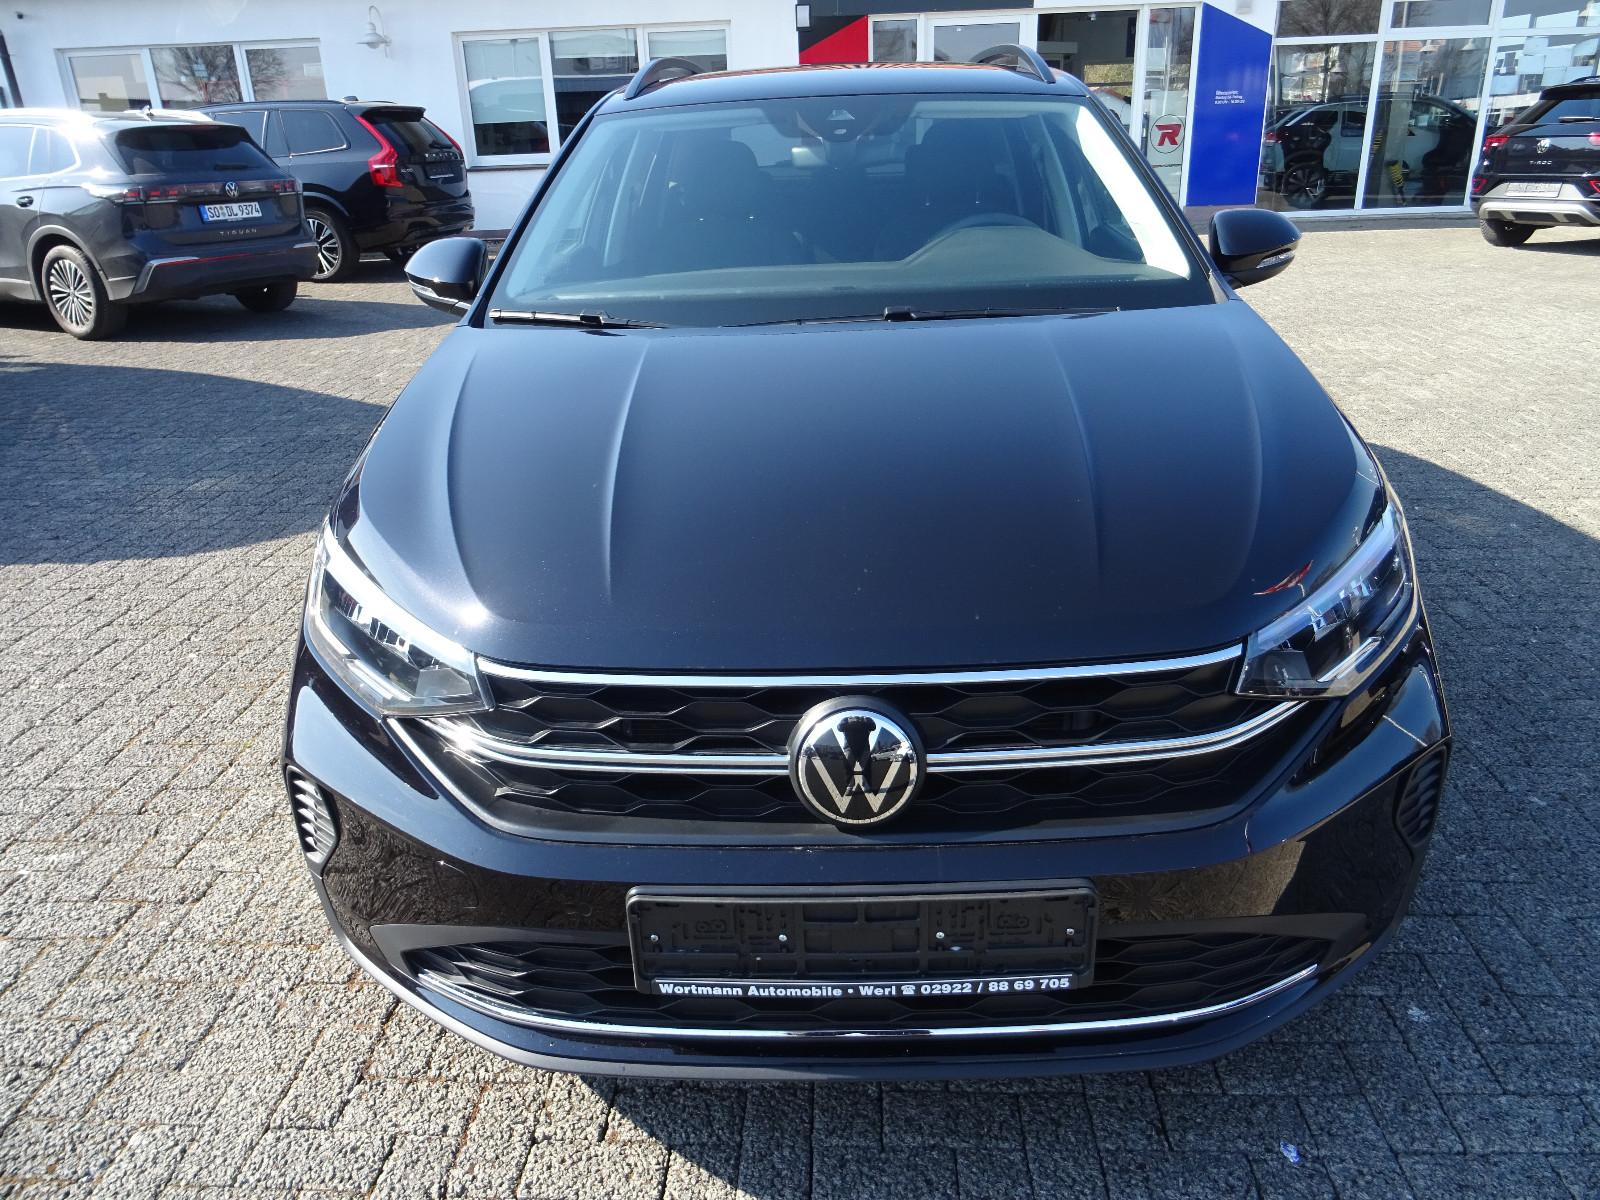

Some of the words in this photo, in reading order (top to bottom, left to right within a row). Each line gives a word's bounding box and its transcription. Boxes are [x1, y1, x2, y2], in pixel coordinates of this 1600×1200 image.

[1156, 123, 1182, 146] R
[207, 205, 220, 218] SO
[225, 205, 238, 217] DL
[239, 204, 260, 216] 9374
[658, 983, 743, 996] Wortmann
[748, 985, 843, 997] Automobile
[858, 985, 896, 996] Werl
[920, 982, 972, 995] 02922
[988, 981, 1009, 992] 88
[1013, 979, 1034, 991] 69
[1039, 977, 1070, 989] 705
